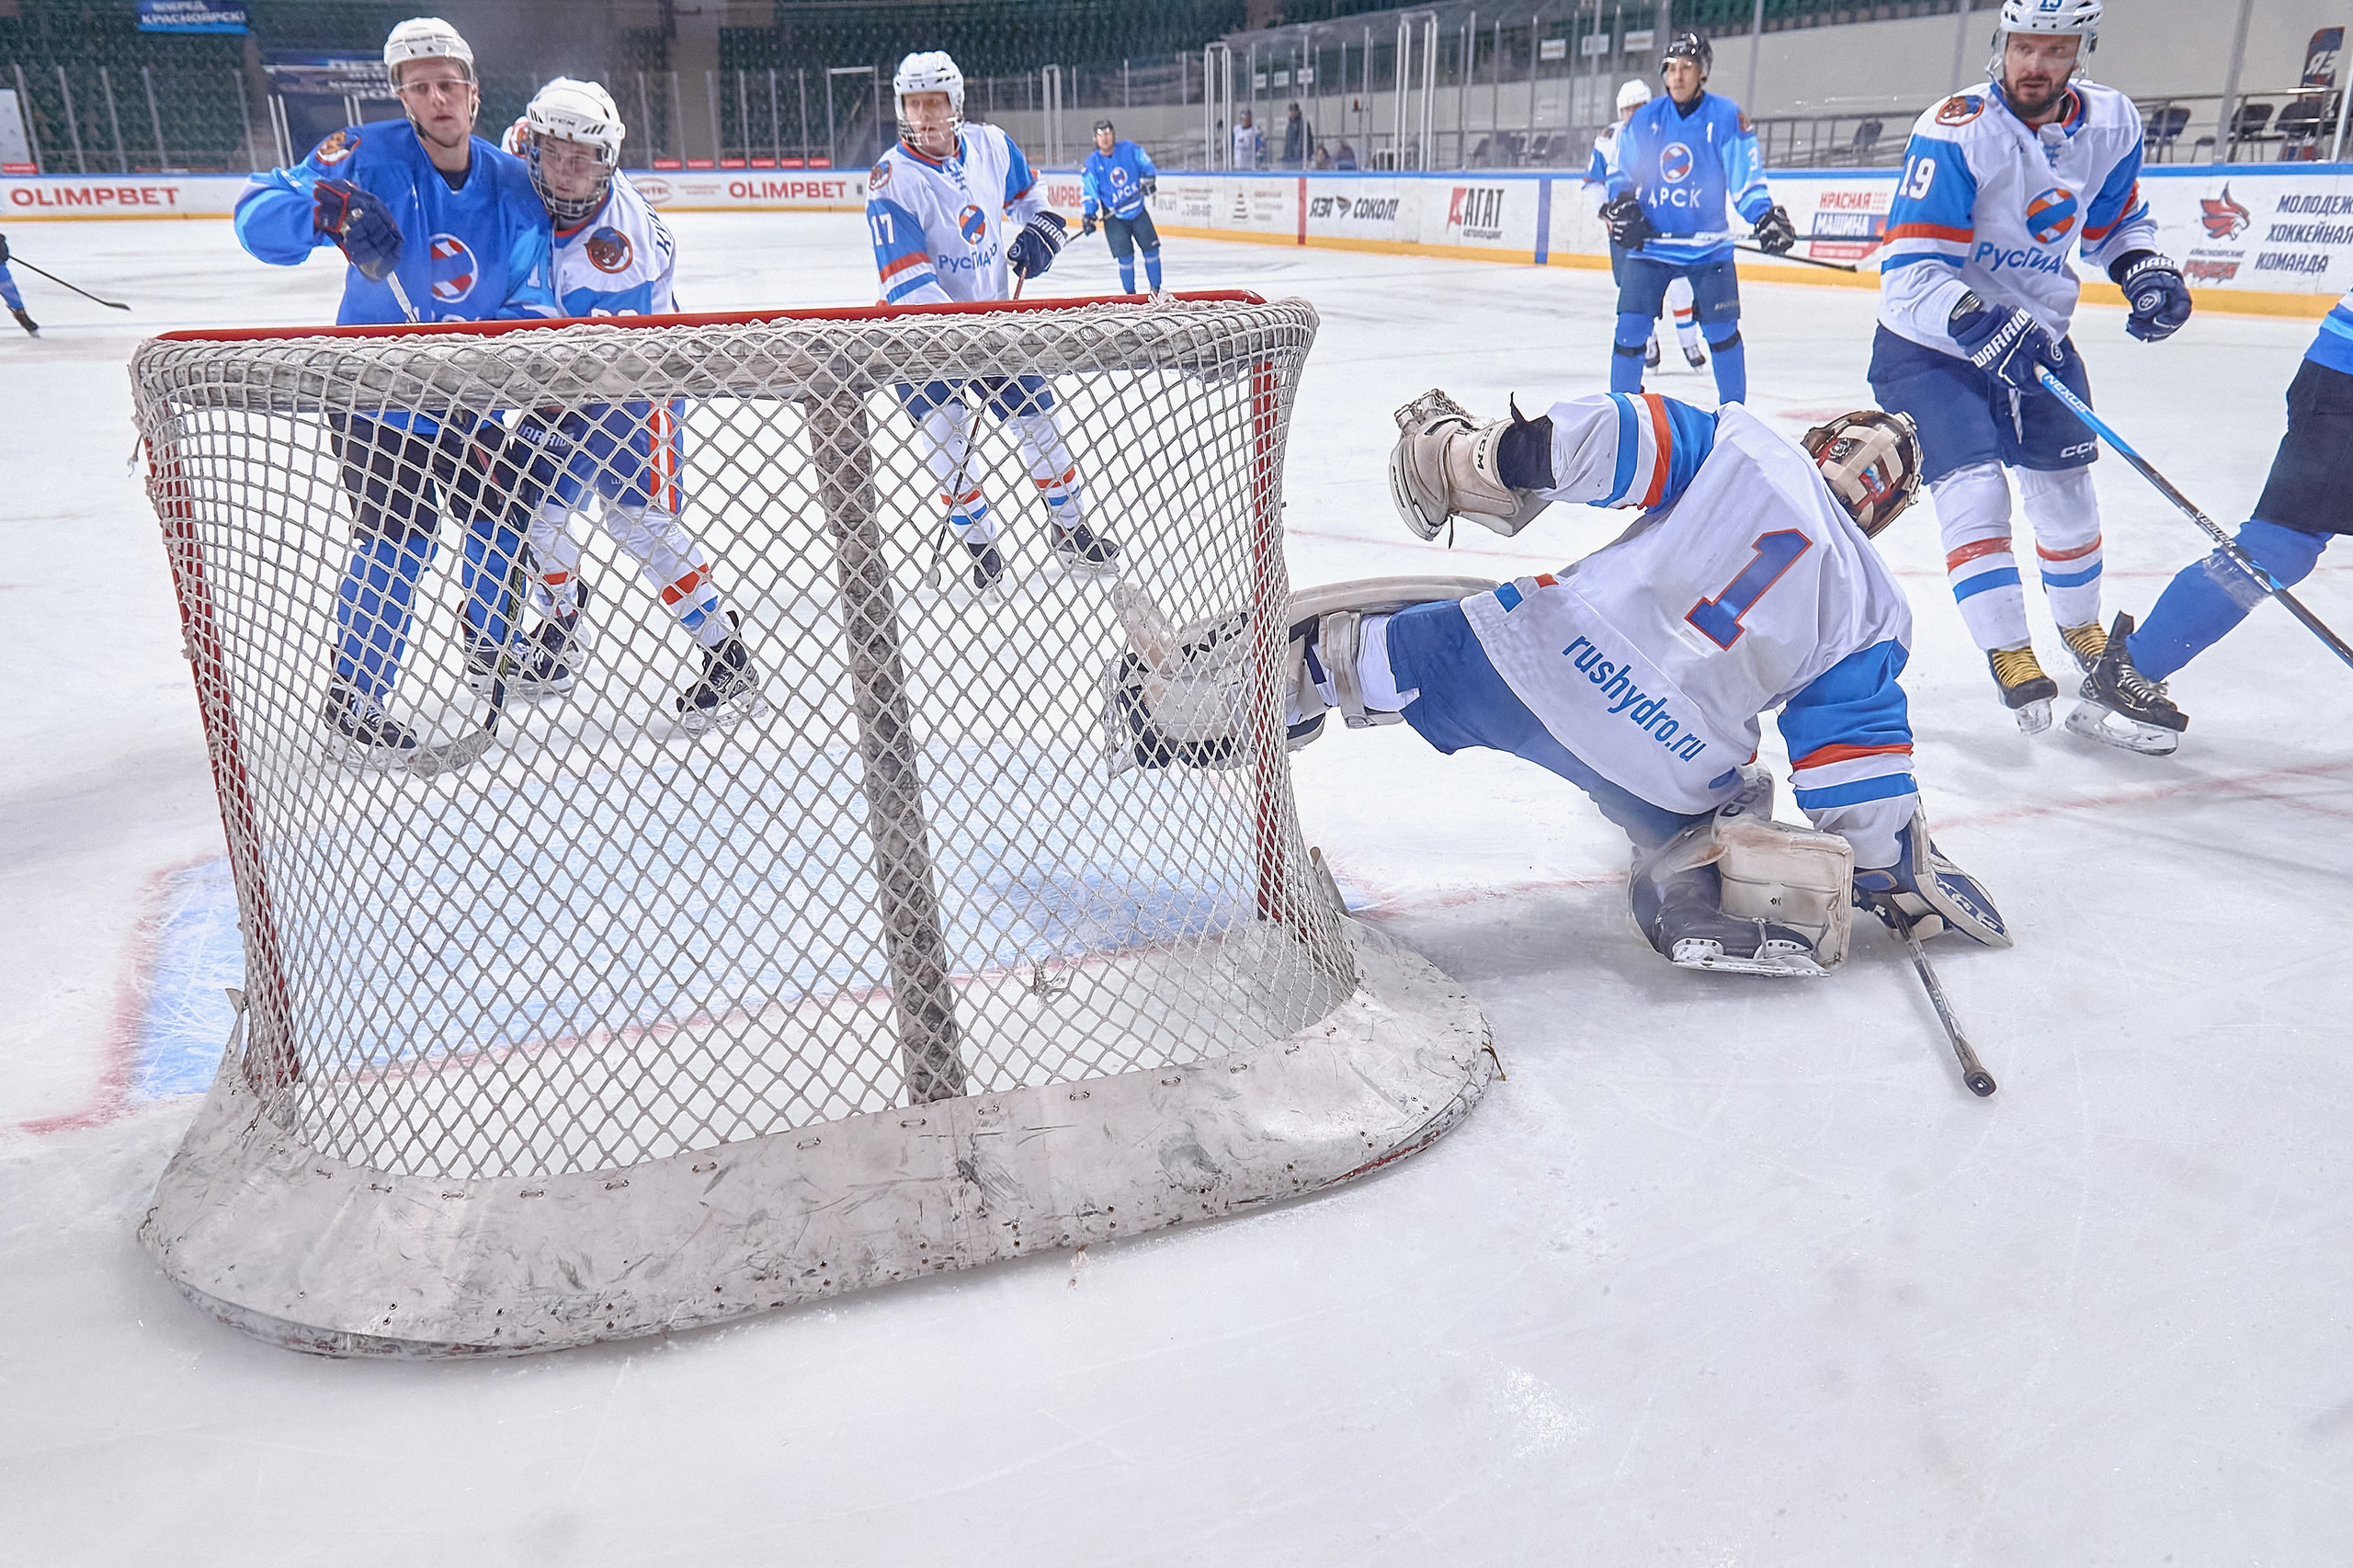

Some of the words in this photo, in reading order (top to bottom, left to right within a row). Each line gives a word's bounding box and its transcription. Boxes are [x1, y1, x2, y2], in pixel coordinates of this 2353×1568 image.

[729, 181, 847, 199] OLIMPBET
[1899, 154, 1937, 200] 19
[10, 187, 179, 207] OLIMPBET
[1463, 187, 1505, 228] АГАТ
[870, 212, 895, 247] 17
[2265, 220, 2353, 244] ХОККЕЙНАЯ
[2254, 252, 2330, 275] КОМАНДА
[2043, 373, 2088, 414] NEXUS
[1684, 528, 1813, 653] 1
[1562, 635, 1707, 763] rushydro.ru
